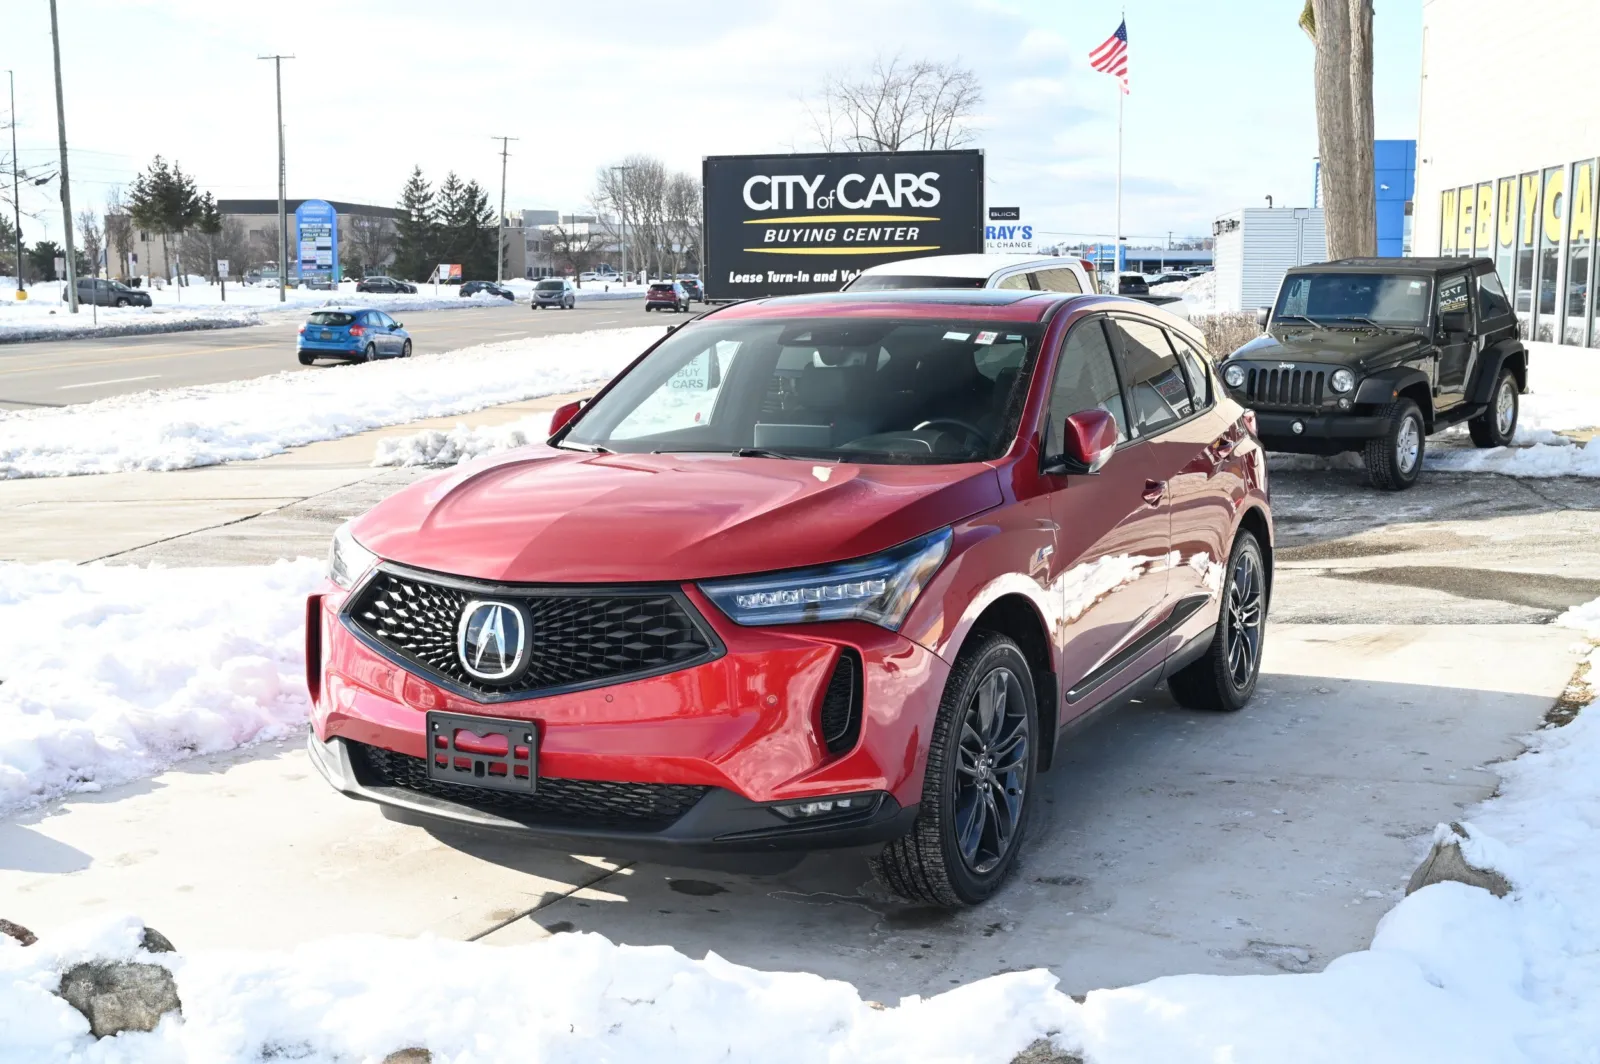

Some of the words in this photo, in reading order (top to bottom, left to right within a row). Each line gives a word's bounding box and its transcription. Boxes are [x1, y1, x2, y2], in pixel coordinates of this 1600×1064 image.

[743, 175, 825, 211] CITY
[817, 189, 836, 209] of
[836, 172, 941, 209] CARS
[1543, 163, 1600, 246] CA
[764, 228, 837, 243] BUYING
[842, 227, 919, 242] CENTER
[985, 225, 1032, 240] RAY'S
[729, 271, 763, 283] Lease
[767, 270, 809, 283] Turn-In
[813, 269, 837, 282] and
[677, 368, 700, 378] BUY
[672, 380, 703, 389] CARS
